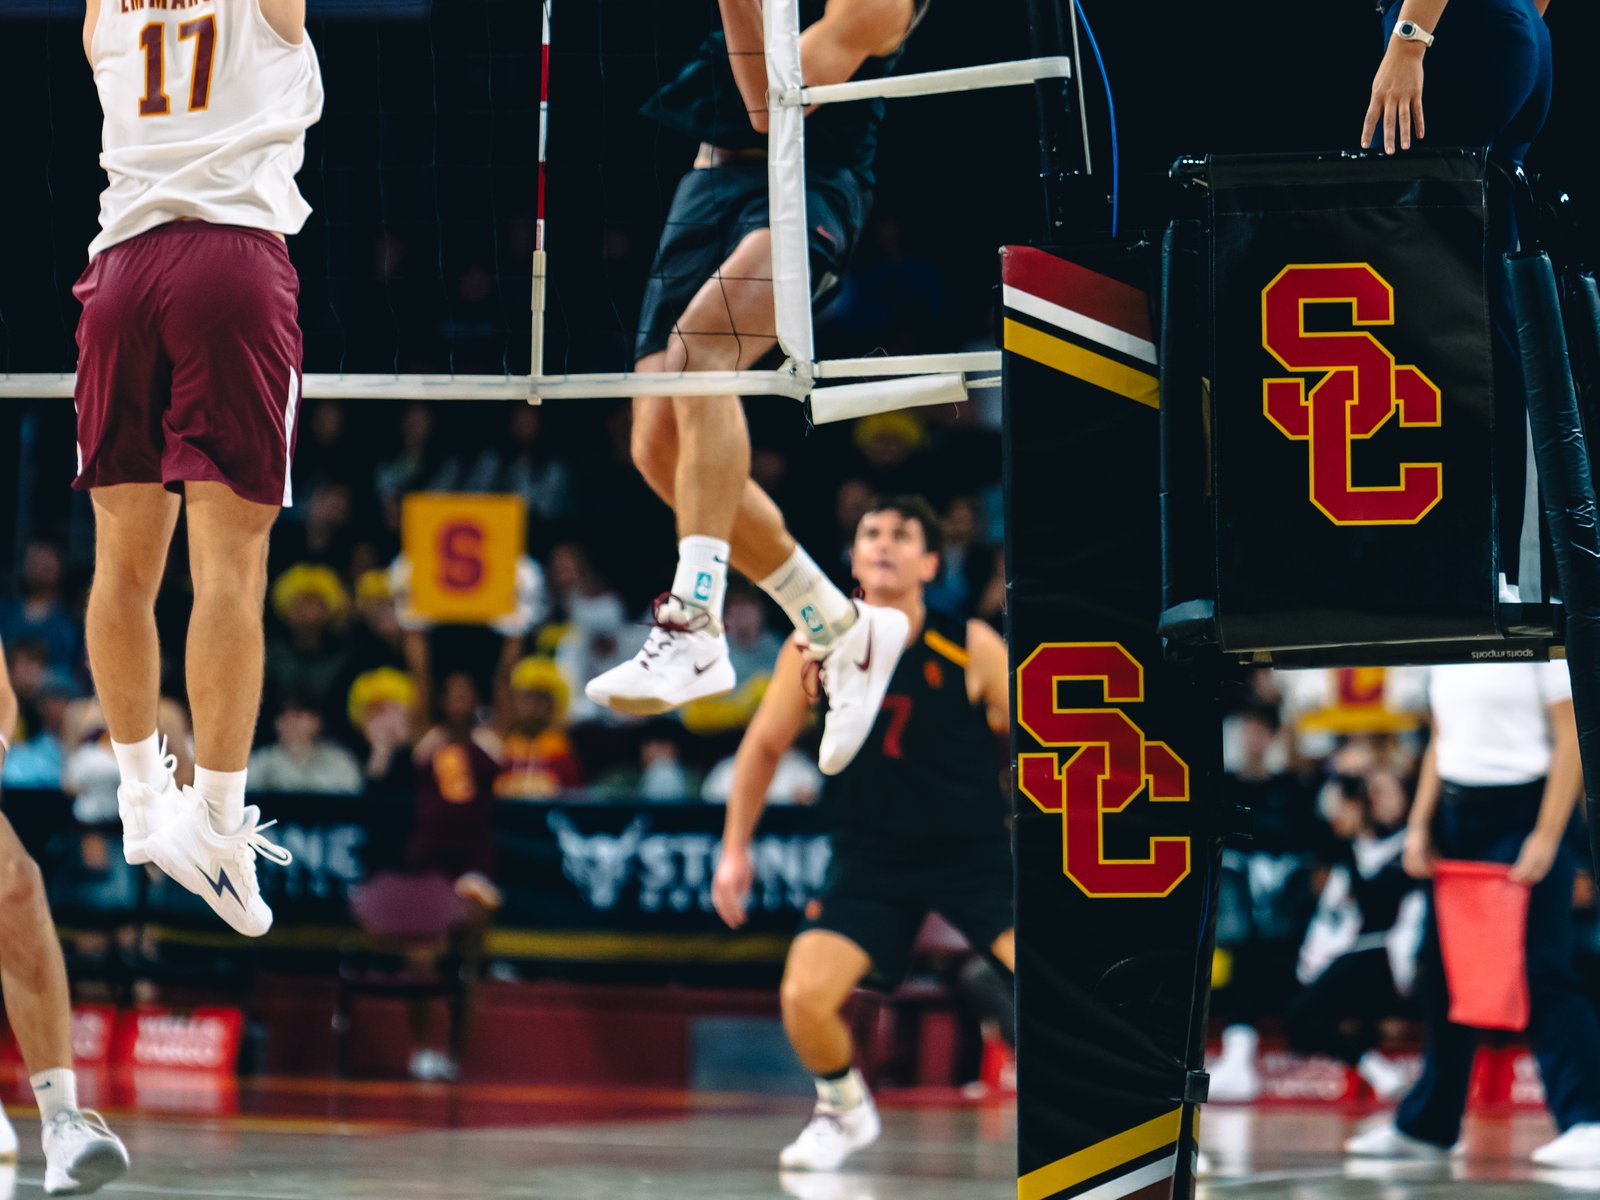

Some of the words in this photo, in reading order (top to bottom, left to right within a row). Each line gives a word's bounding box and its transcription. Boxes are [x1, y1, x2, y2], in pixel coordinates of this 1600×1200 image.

[138, 13, 218, 117] 17
[1262, 263, 1442, 526] SC
[440, 521, 484, 590] S
[1017, 641, 1191, 898] SC
